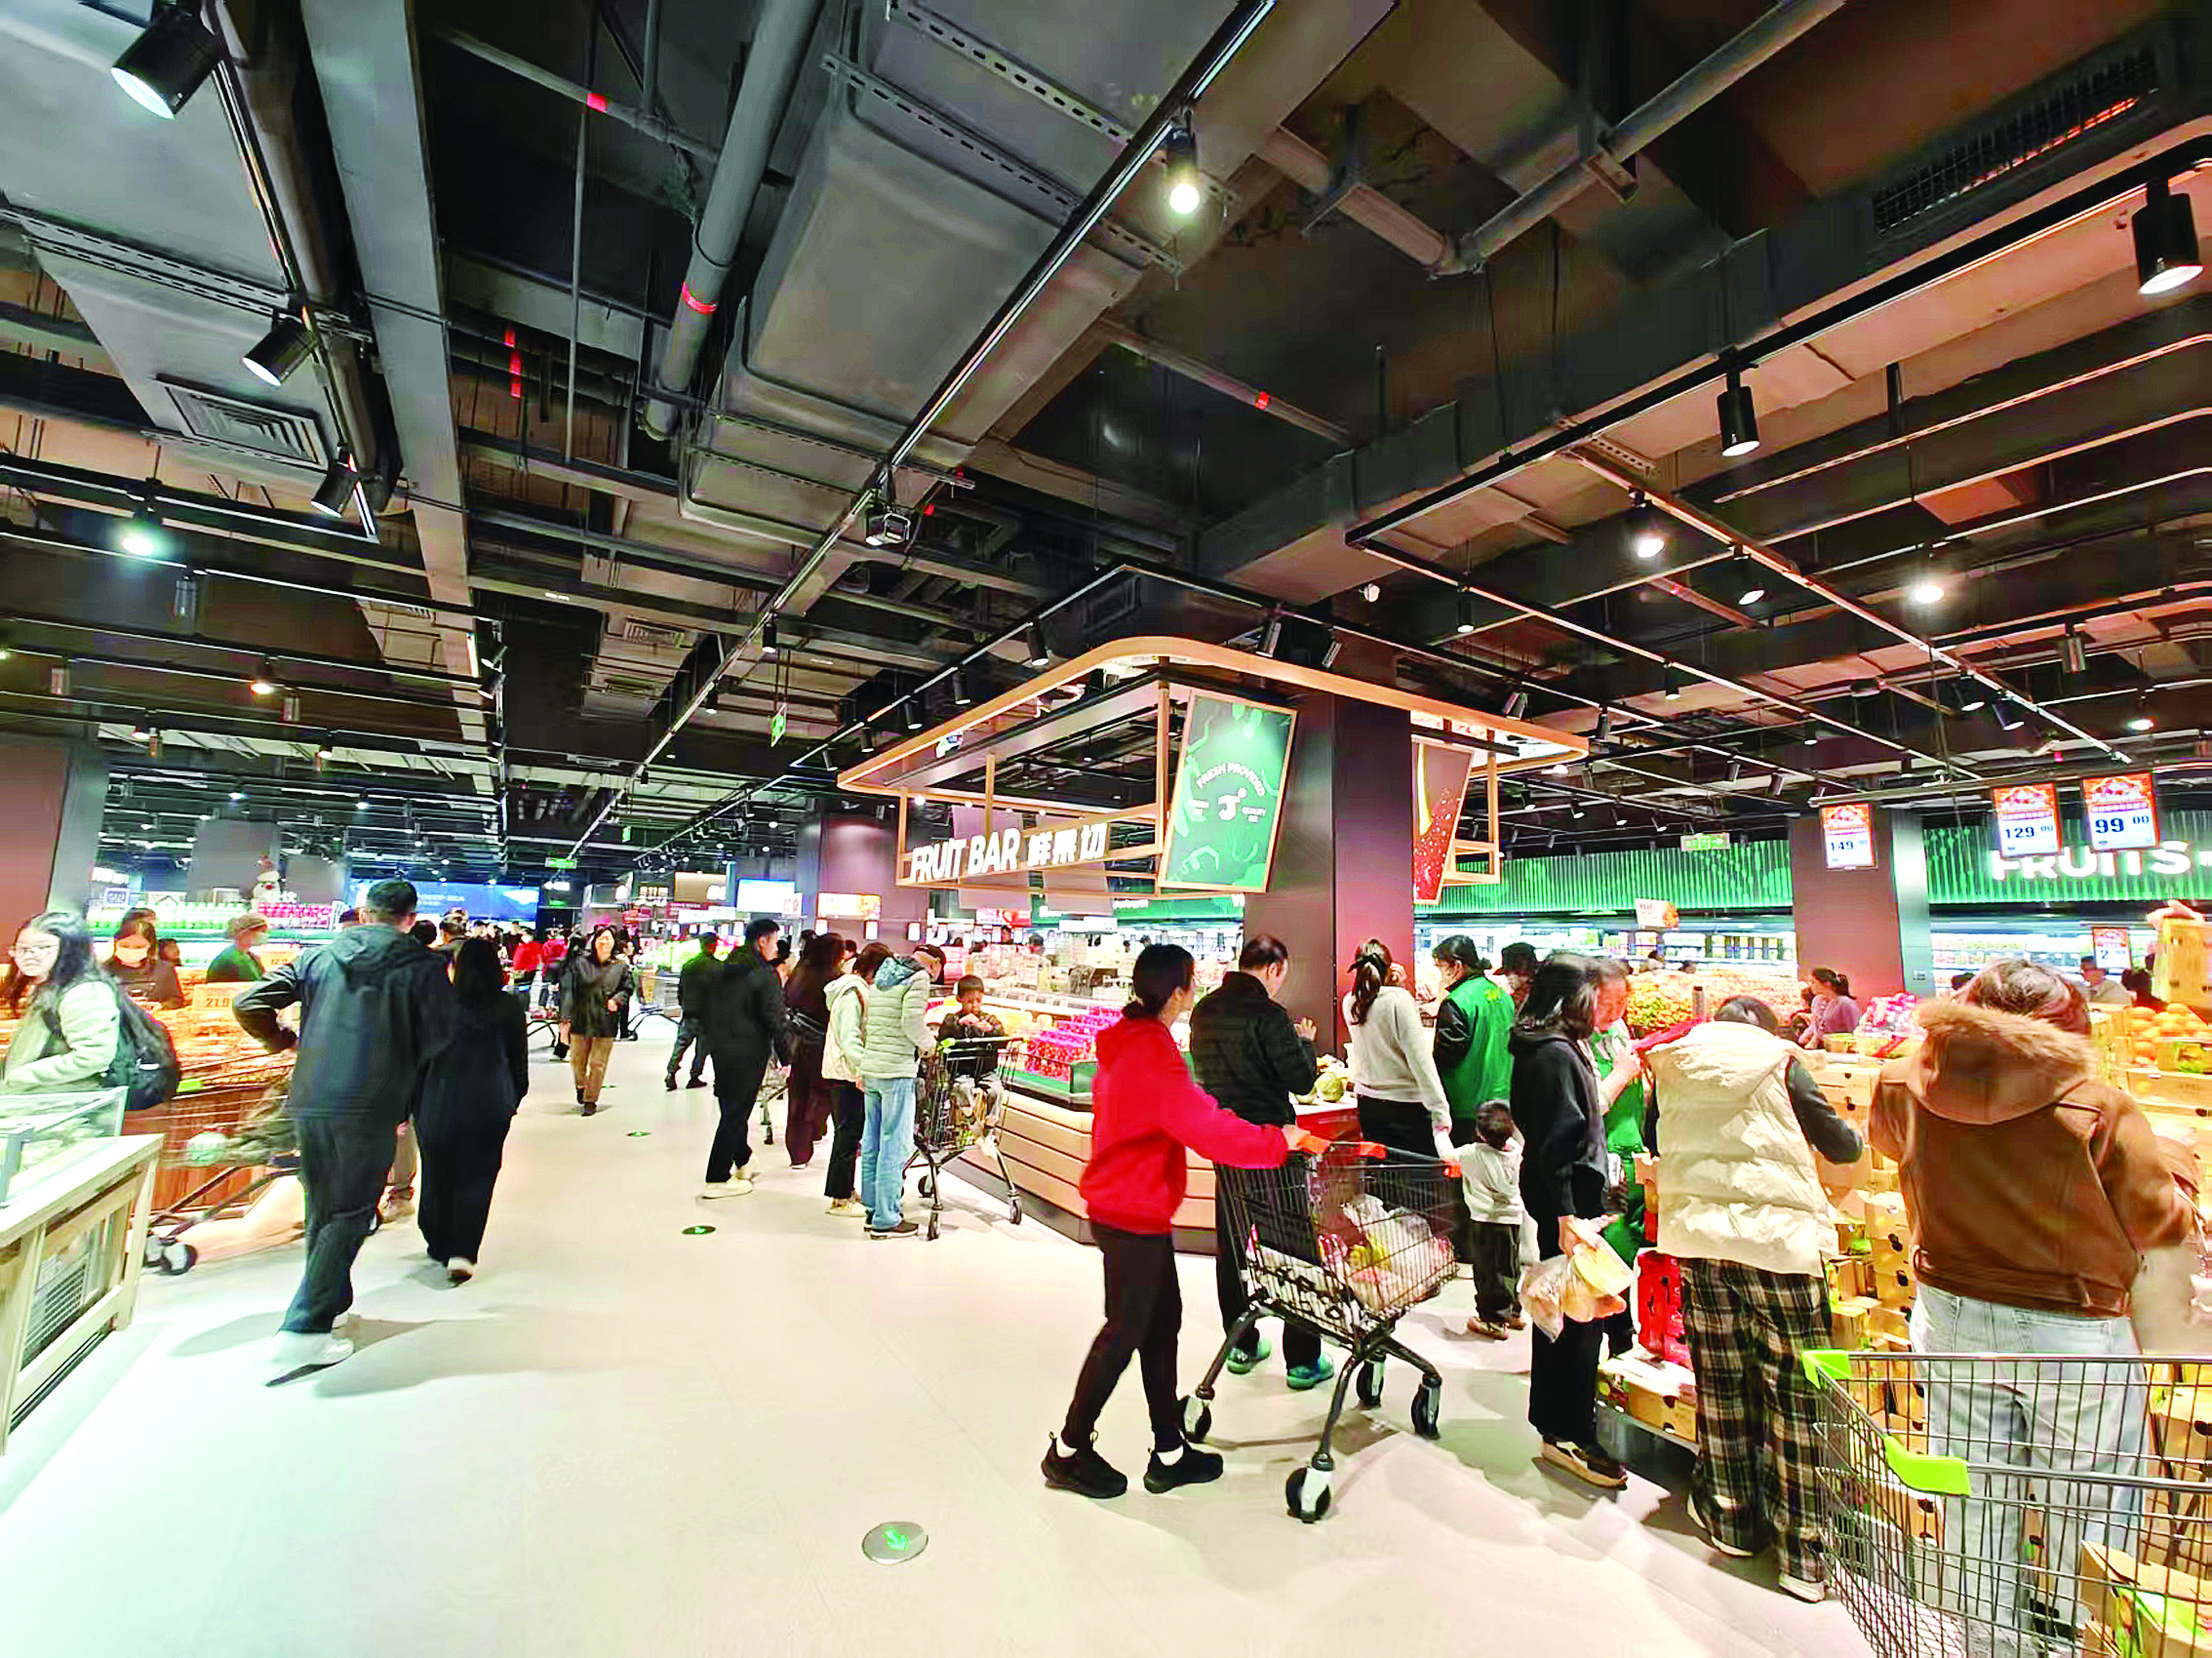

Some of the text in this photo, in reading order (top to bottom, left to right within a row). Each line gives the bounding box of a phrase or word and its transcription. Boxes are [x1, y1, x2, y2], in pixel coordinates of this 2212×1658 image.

[1197, 763, 1266, 798] FRESH PROVIDED
[1242, 807, 1267, 817] QUALITY
[2004, 826, 2035, 840] 129
[2095, 815, 2150, 834] 99 00
[1026, 822, 1108, 867] 鲜果切
[1831, 840, 1854, 851] 149
[910, 828, 1021, 883] FRUIT BAR
